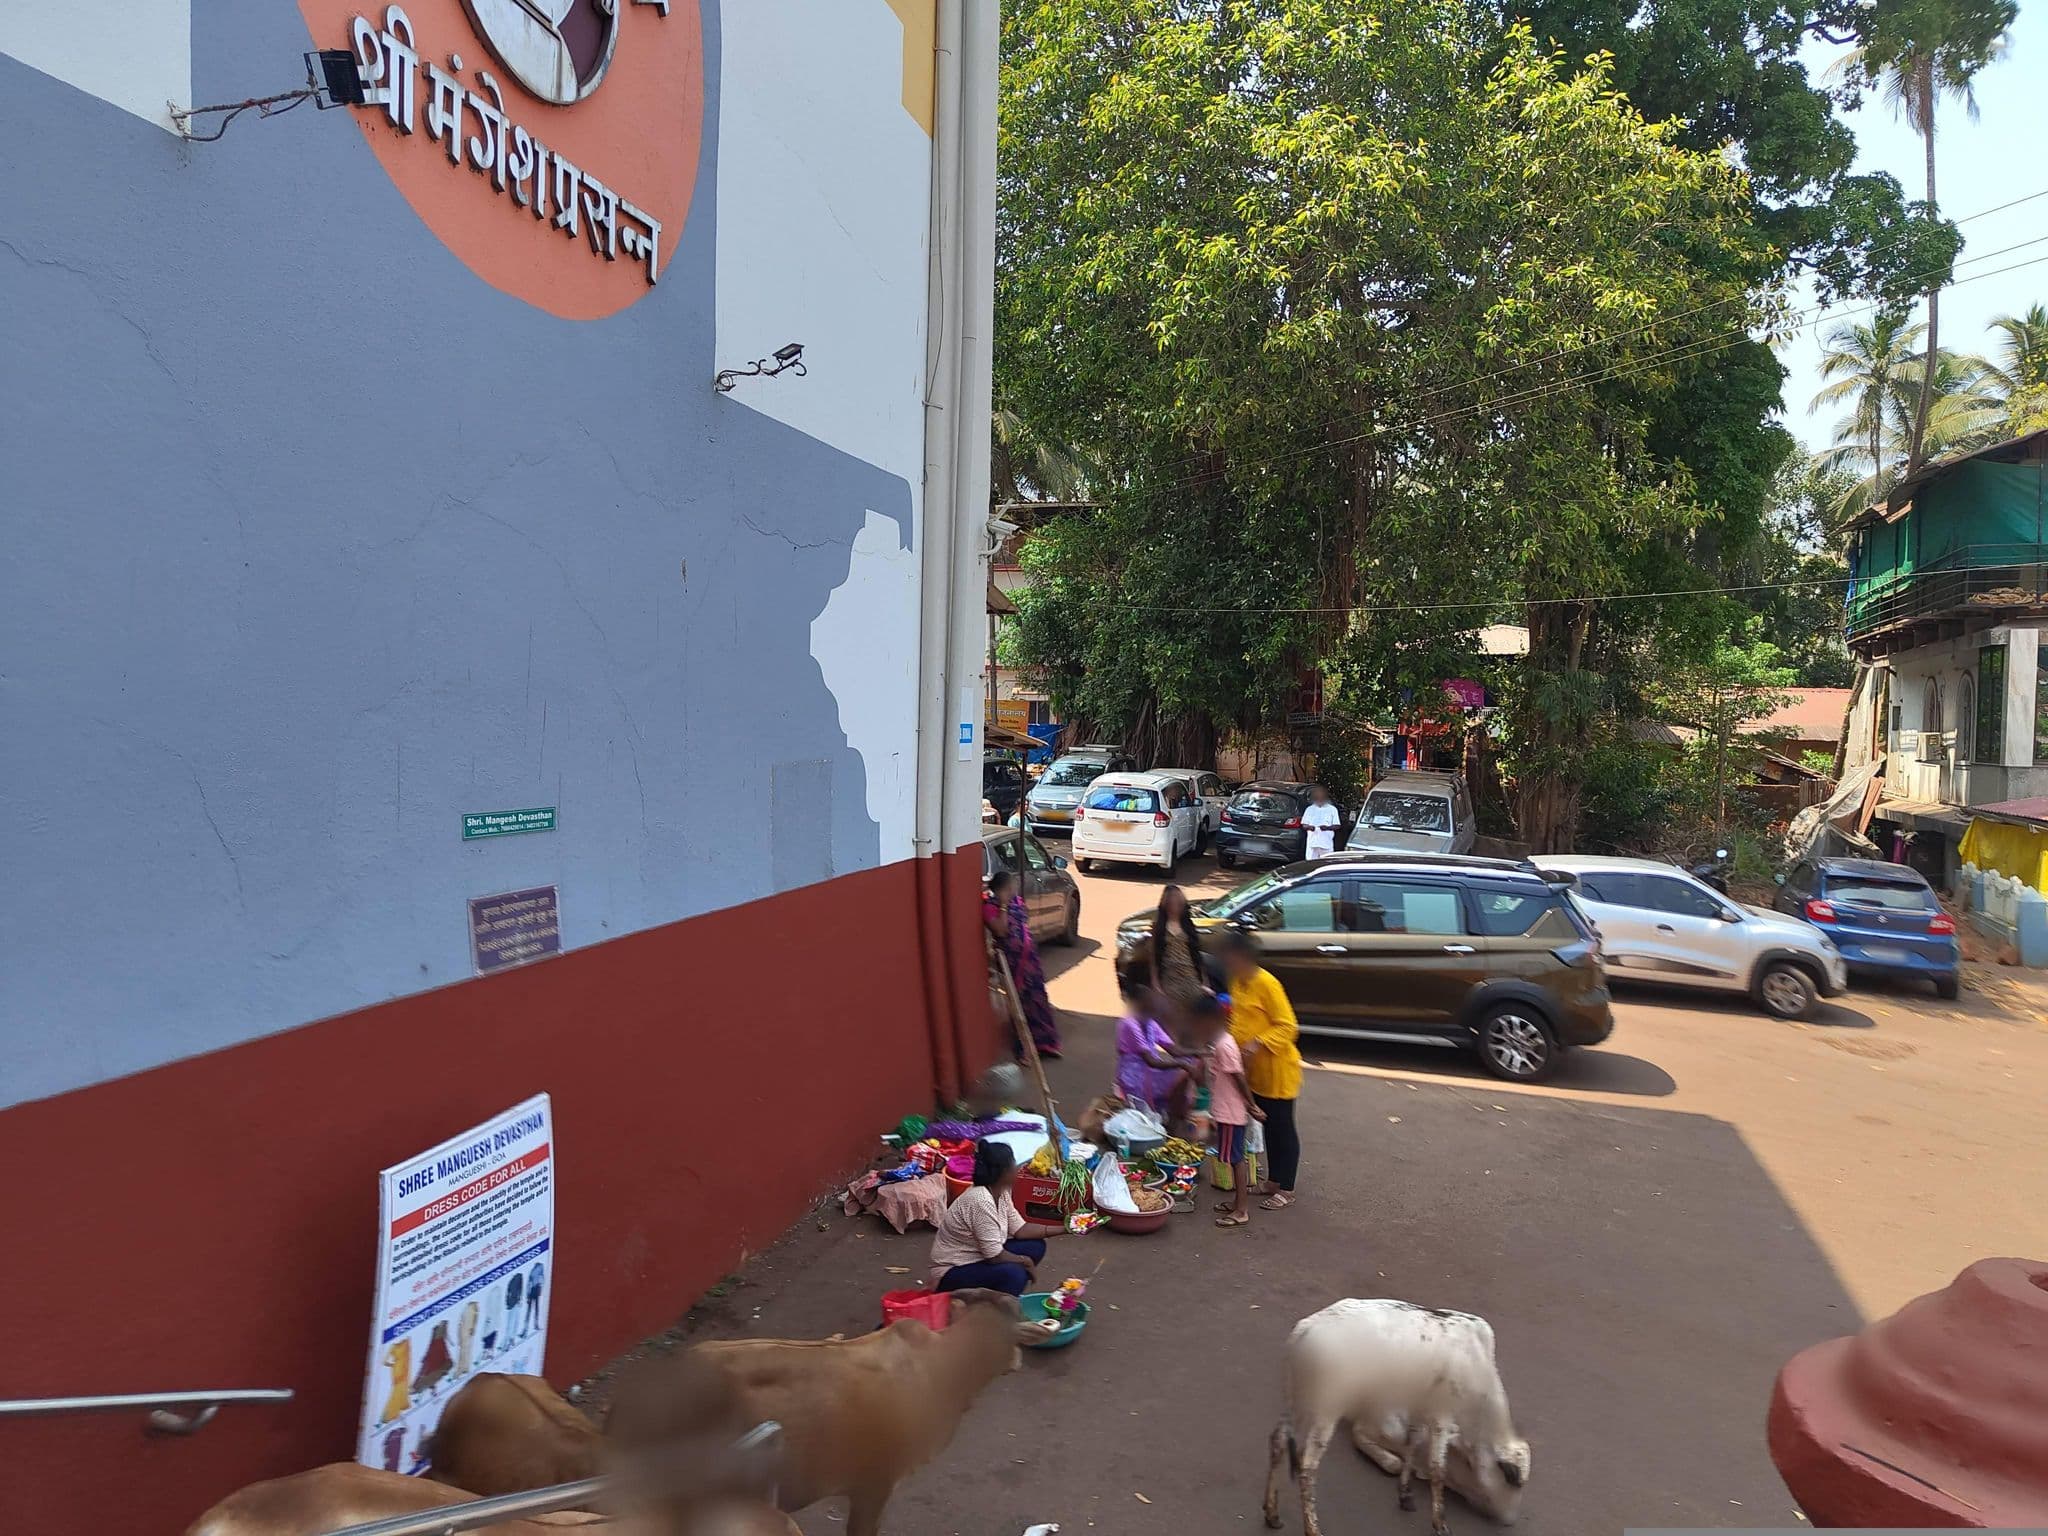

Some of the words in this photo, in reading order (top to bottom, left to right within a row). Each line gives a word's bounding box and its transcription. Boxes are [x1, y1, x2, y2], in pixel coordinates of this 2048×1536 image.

[347, 3, 419, 136] श्री
[466, 817, 484, 827] Shri.
[485, 814, 517, 826] Mangesh
[518, 811, 553, 822] Devasthan
[399, 1166, 433, 1198] SHREE
[437, 1138, 491, 1179] MANGUESH
[493, 1111, 544, 1150] DEVASTHAN
[424, 1196, 459, 1219] DRESS
[461, 1180, 487, 1202] CODE
[490, 1171, 508, 1187] FOR
[510, 1159, 526, 1176] ALL
